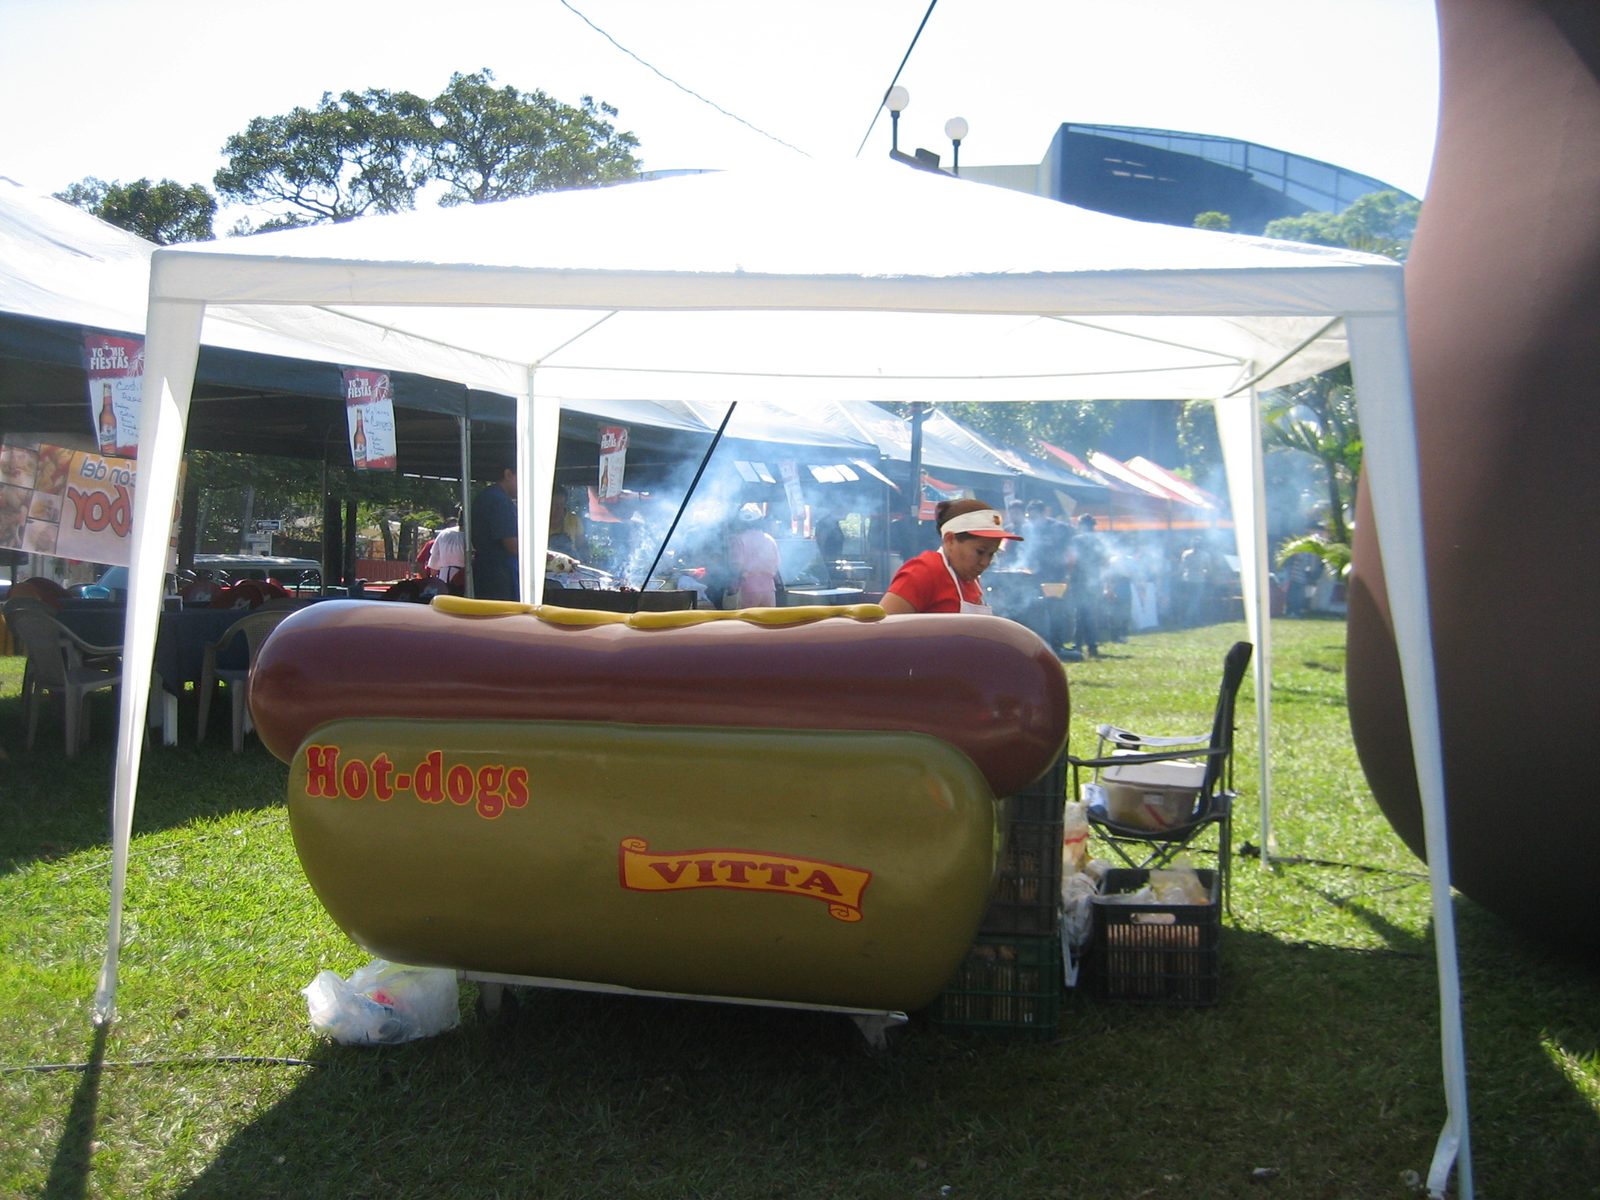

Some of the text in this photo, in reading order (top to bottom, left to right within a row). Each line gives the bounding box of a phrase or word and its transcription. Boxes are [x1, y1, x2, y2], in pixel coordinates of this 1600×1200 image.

[90, 356, 129, 370] FIESTAS
[348, 386, 372, 398] FIESTAS
[305, 744, 530, 820] Hot-dogs
[649, 860, 843, 896] VITTA
